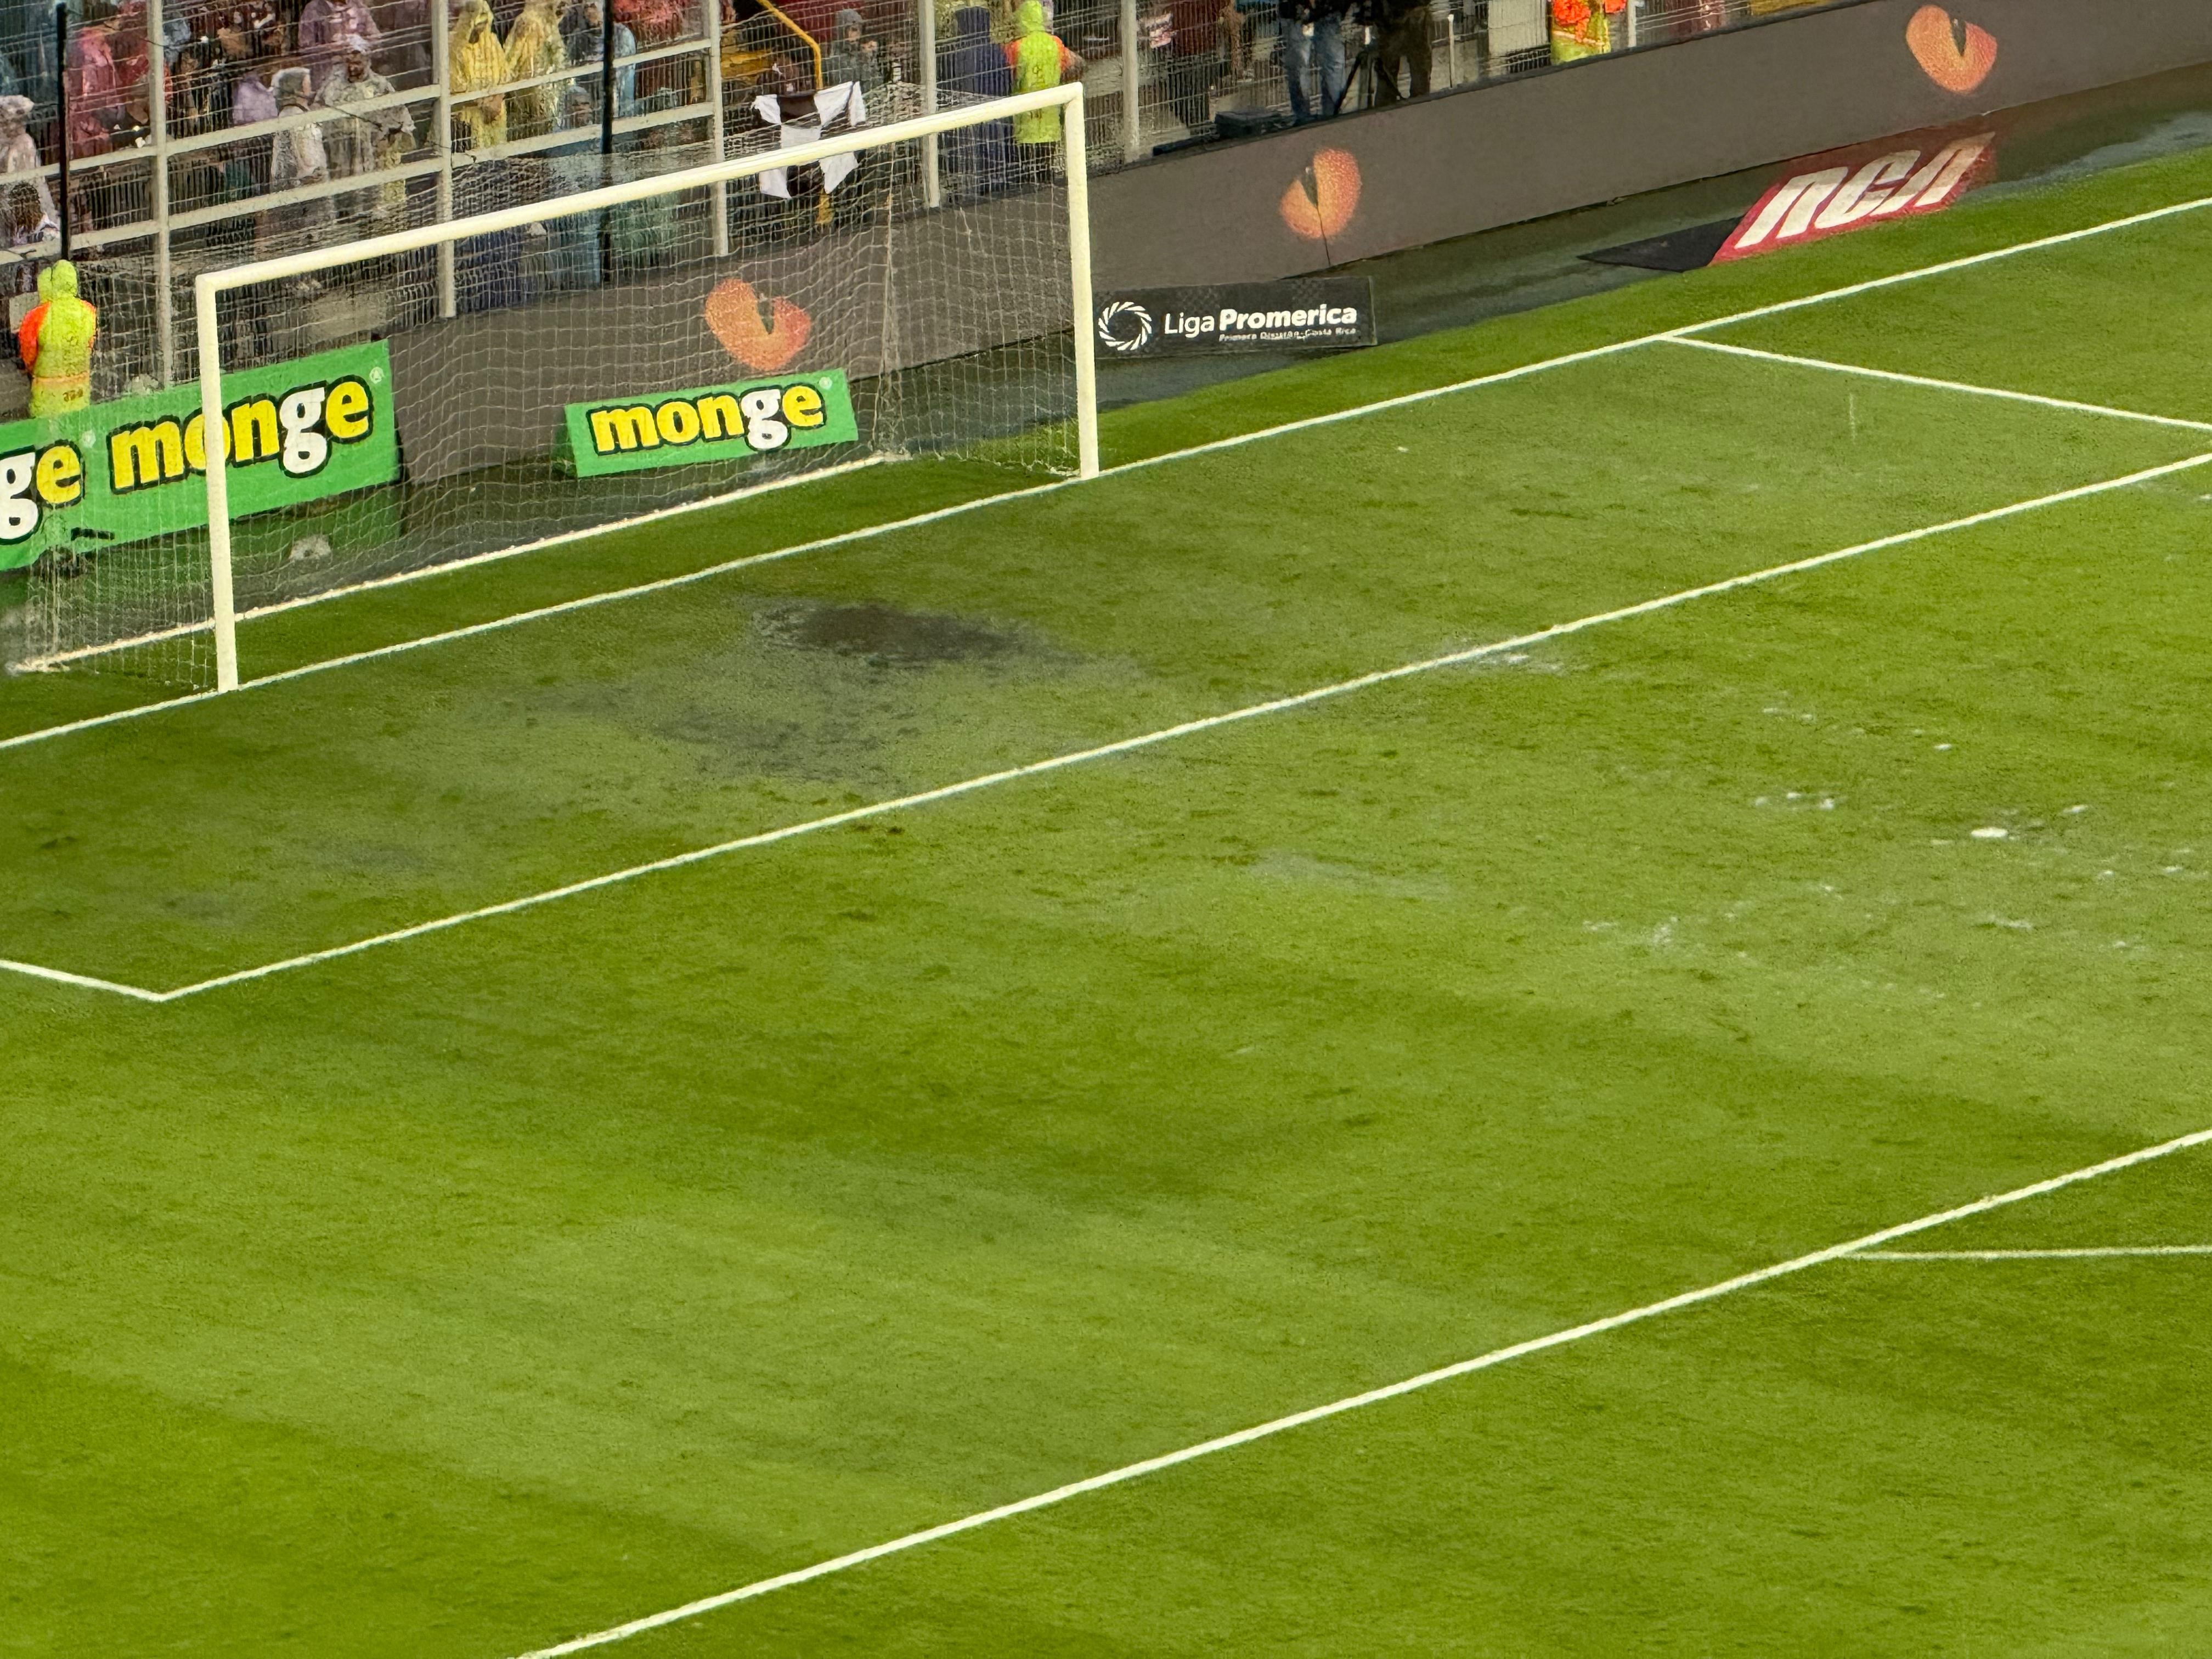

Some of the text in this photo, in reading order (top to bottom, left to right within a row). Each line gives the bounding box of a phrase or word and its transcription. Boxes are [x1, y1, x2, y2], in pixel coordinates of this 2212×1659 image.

[1164, 303, 1357, 338] Liga Promerica
[588, 383, 825, 453] monge
